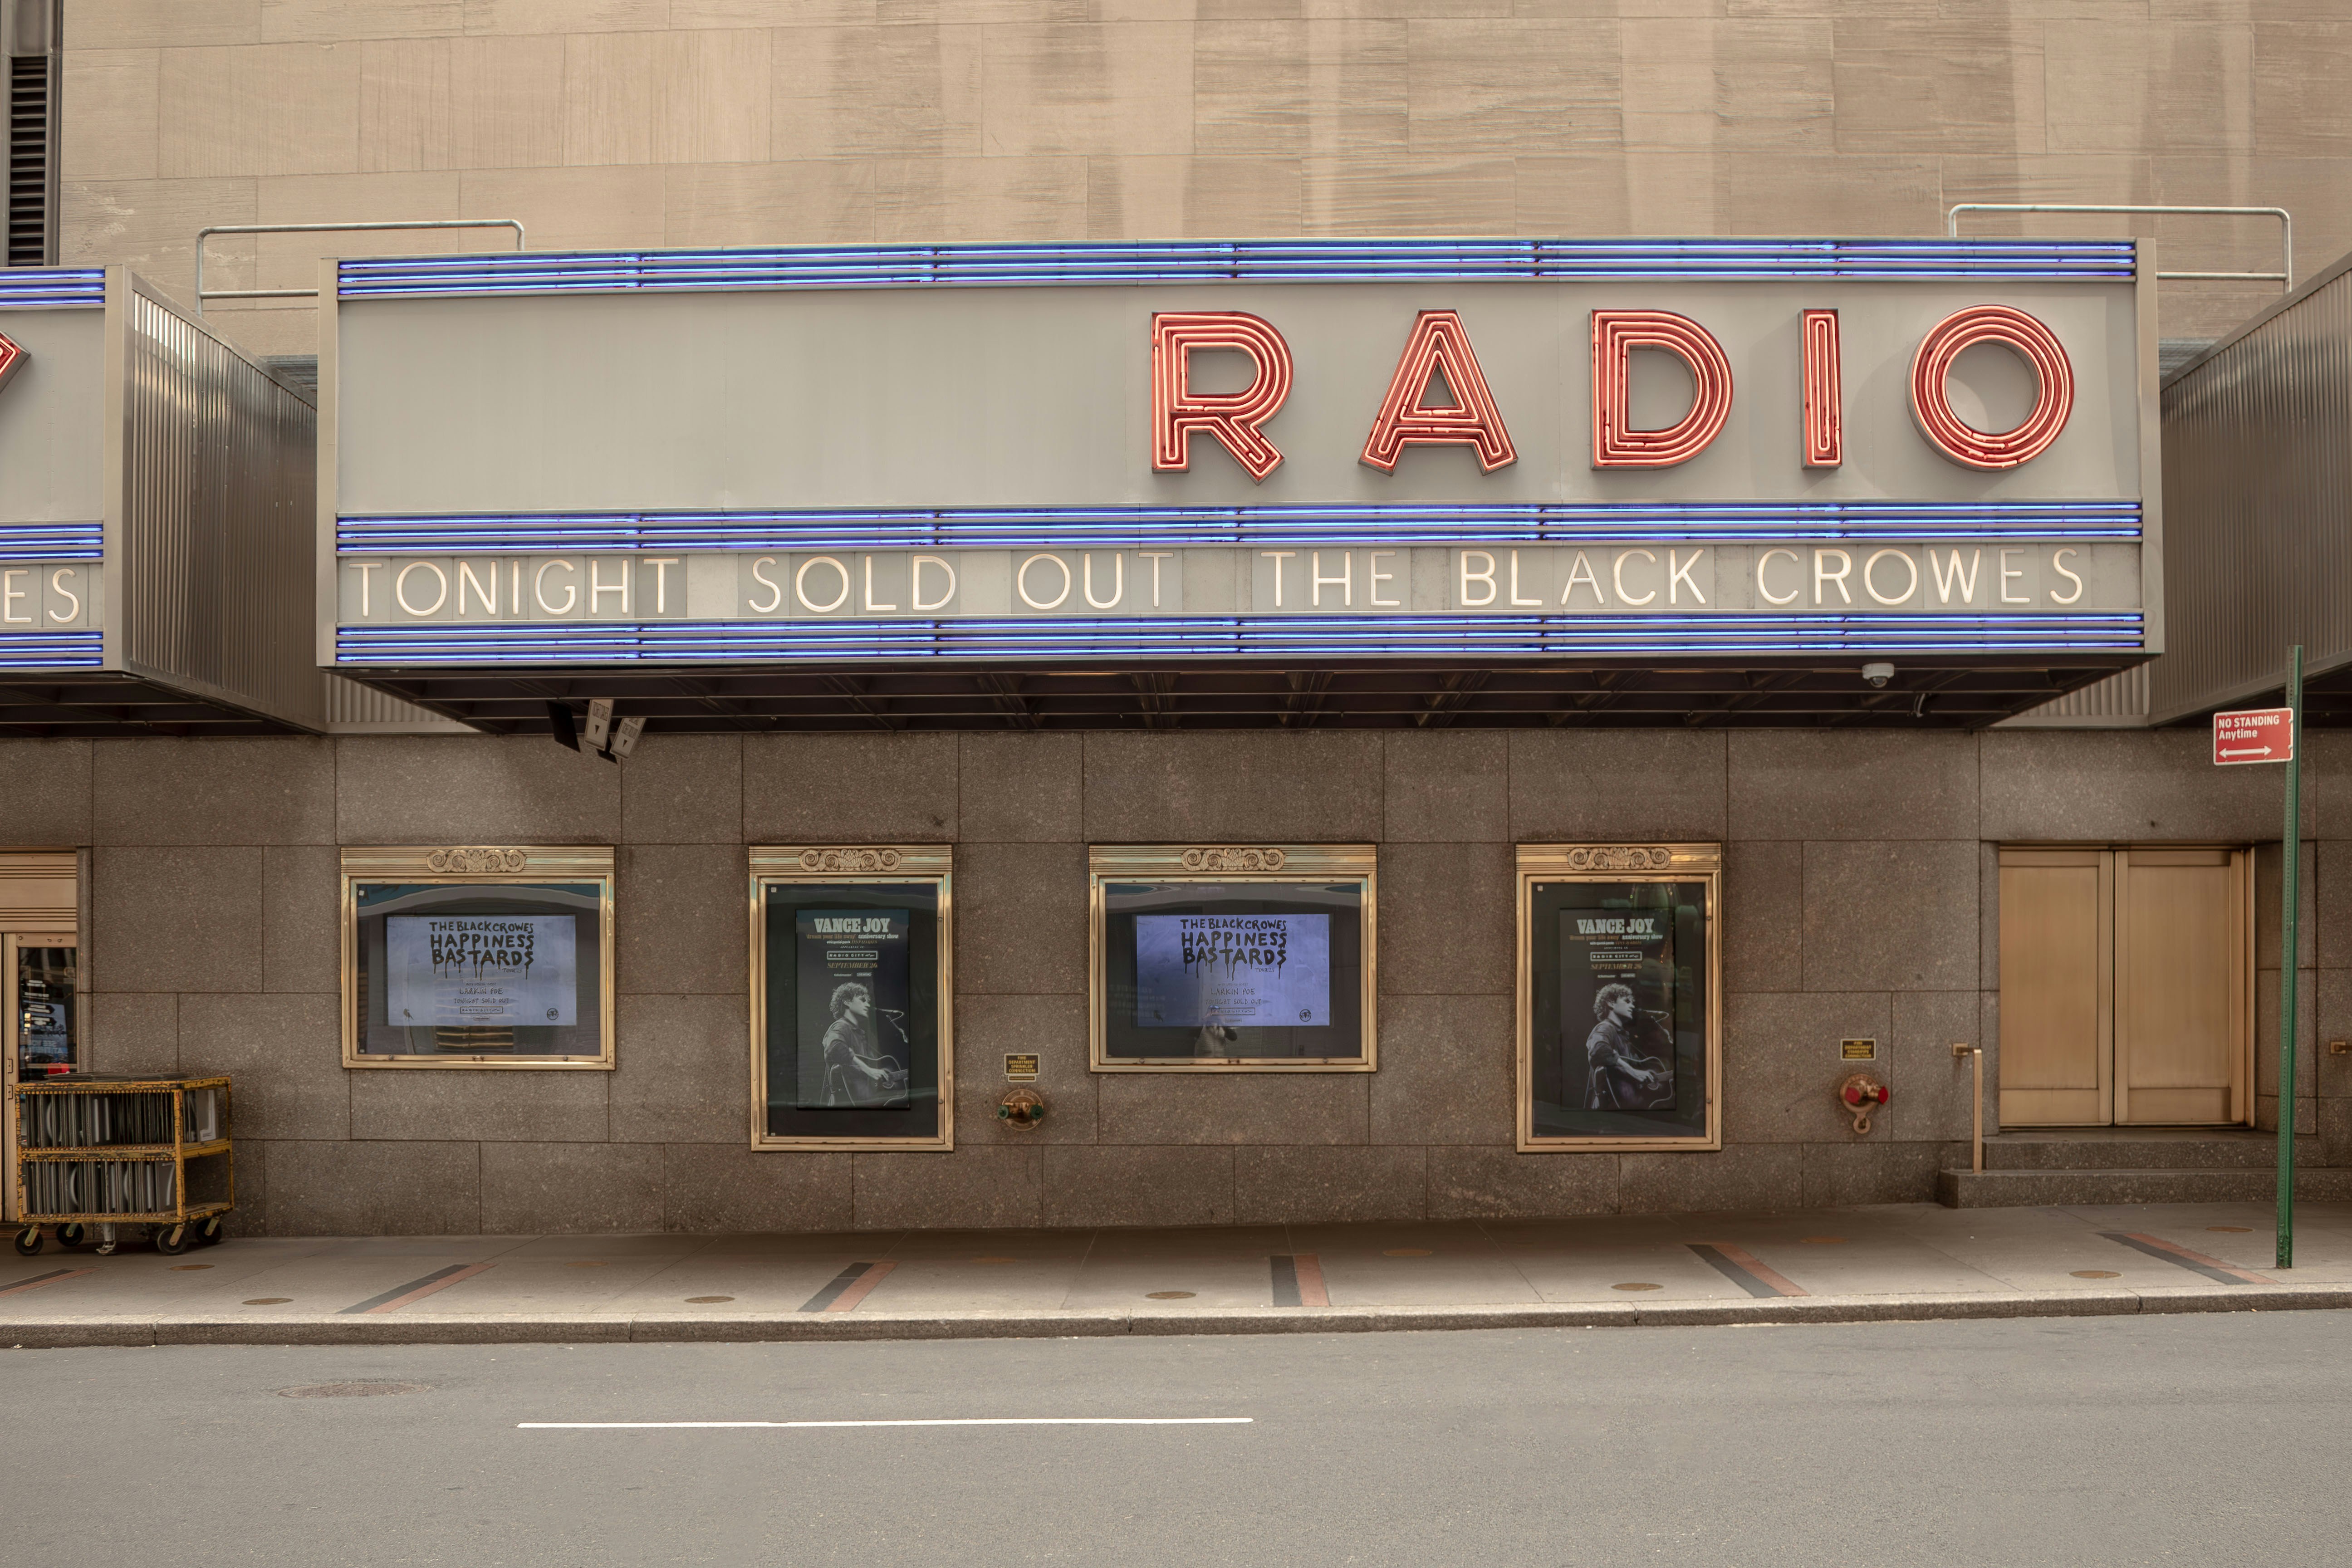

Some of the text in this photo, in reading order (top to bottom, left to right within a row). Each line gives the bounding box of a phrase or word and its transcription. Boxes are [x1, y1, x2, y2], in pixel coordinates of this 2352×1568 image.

[1149, 304, 2075, 484] RADIO
[349, 548, 2082, 617] TONIGHT SOLD OUT THE BLACK CROWES
[2219, 715, 2280, 728] NO STANDING
[2219, 728, 2258, 741] Anytime
[429, 921, 534, 934] THE BLACK CROWES
[814, 918, 890, 933] VANCE JOY
[1180, 918, 1287, 931] THE BLACK CROWES
[1577, 918, 1655, 934] VANCE JOY
[430, 933, 534, 950] HAPPINESS
[1181, 931, 1287, 948] HAPPINESS
[432, 949, 534, 972] BASTARDS
[1183, 947, 1287, 972] BASTARDS
